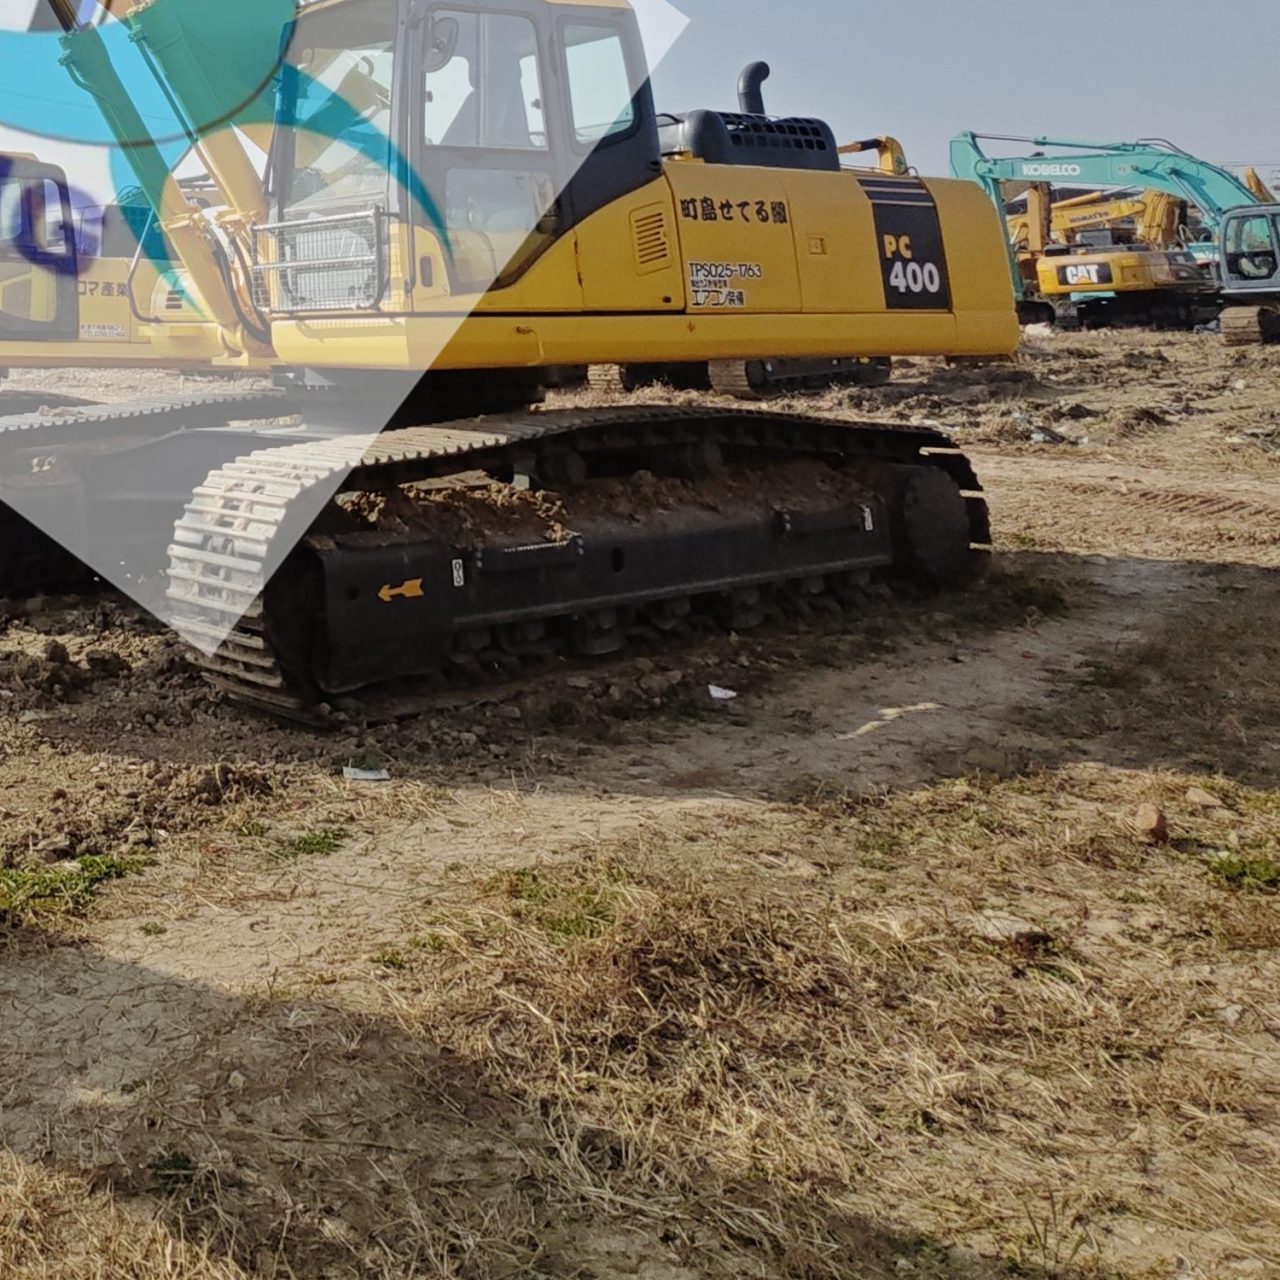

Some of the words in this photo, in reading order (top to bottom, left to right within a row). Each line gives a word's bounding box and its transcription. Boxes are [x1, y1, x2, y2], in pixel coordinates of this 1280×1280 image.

[1022, 164, 1080, 176] KOBELCO
[883, 234, 912, 259] PC
[889, 261, 940, 293] 400
[1066, 265, 1099, 284] CAT
